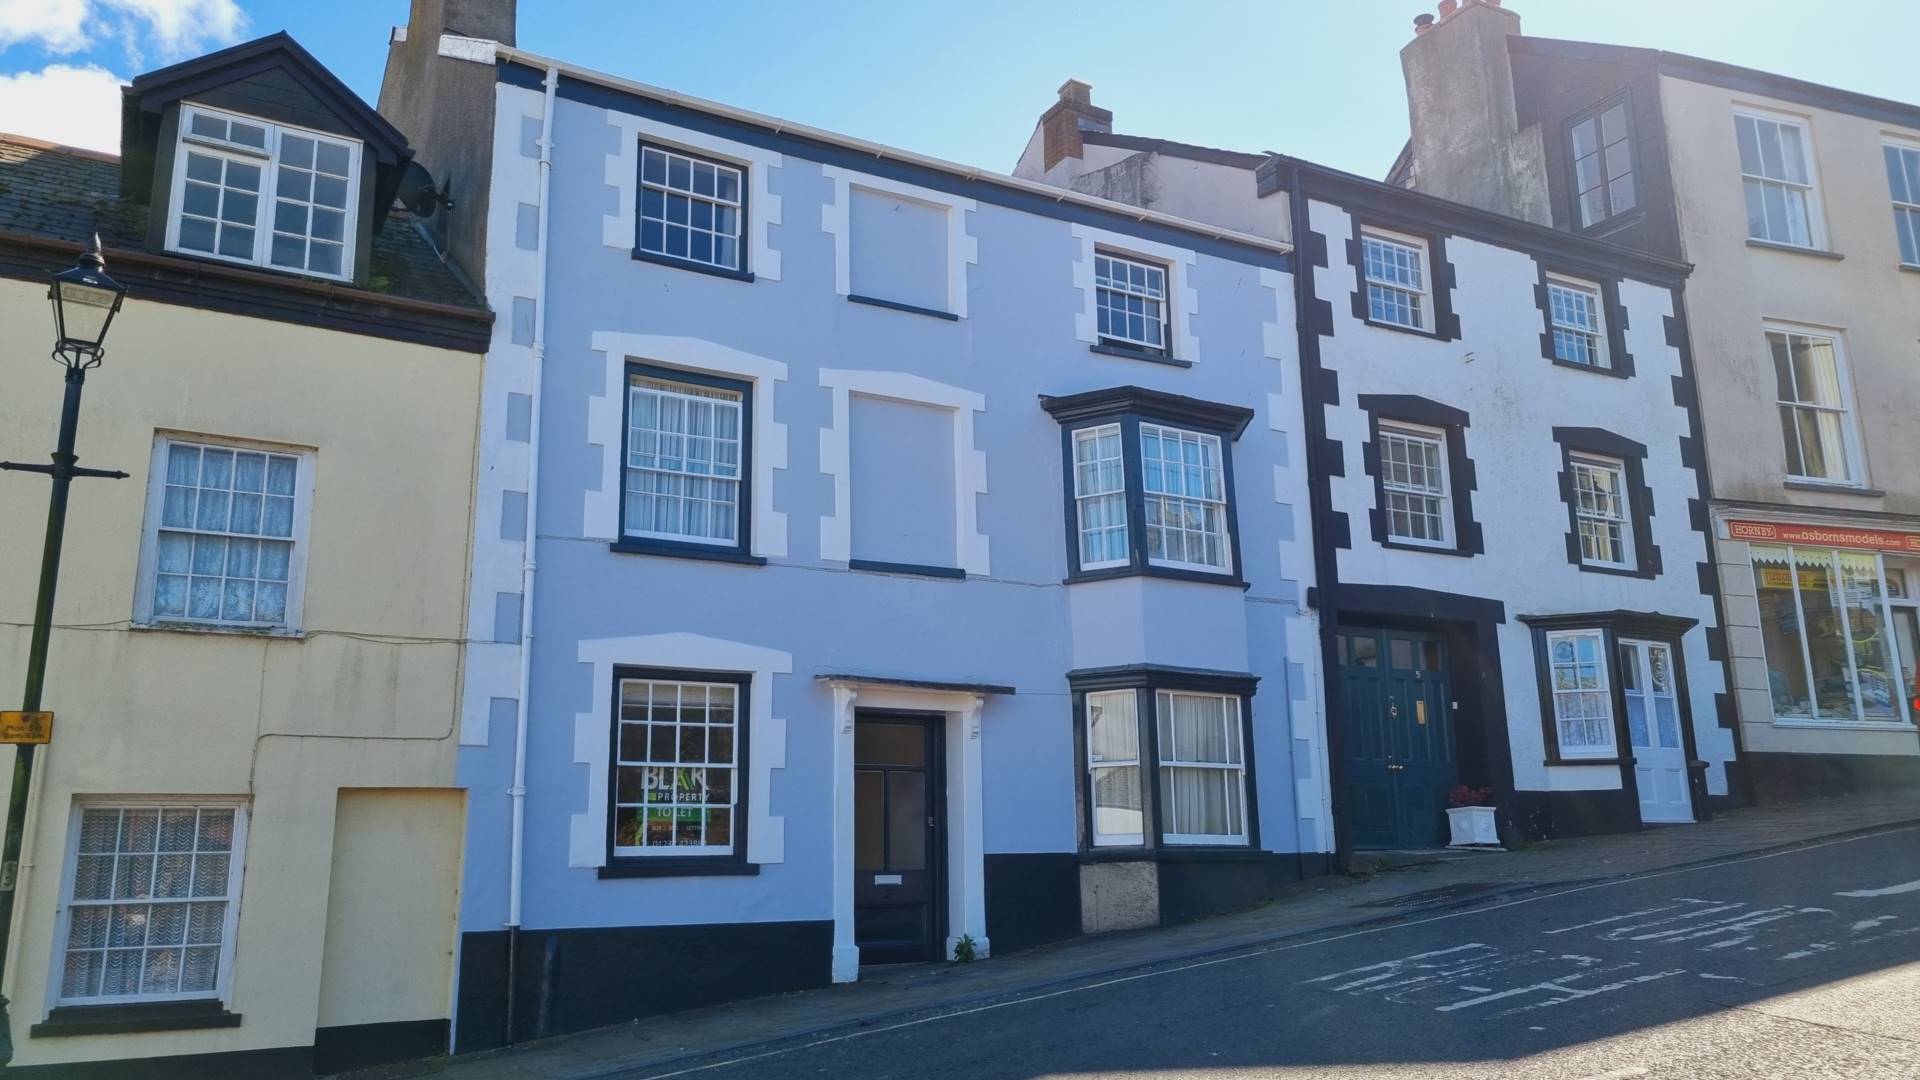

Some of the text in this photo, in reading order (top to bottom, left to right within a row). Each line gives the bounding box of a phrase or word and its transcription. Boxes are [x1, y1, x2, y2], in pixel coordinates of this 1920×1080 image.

[1783, 530, 1901, 546] www.osbornsmodels.com
[1415, 670, 1421, 679] 5
[658, 792, 710, 801] PROPERTY
[657, 807, 671, 817] TO
